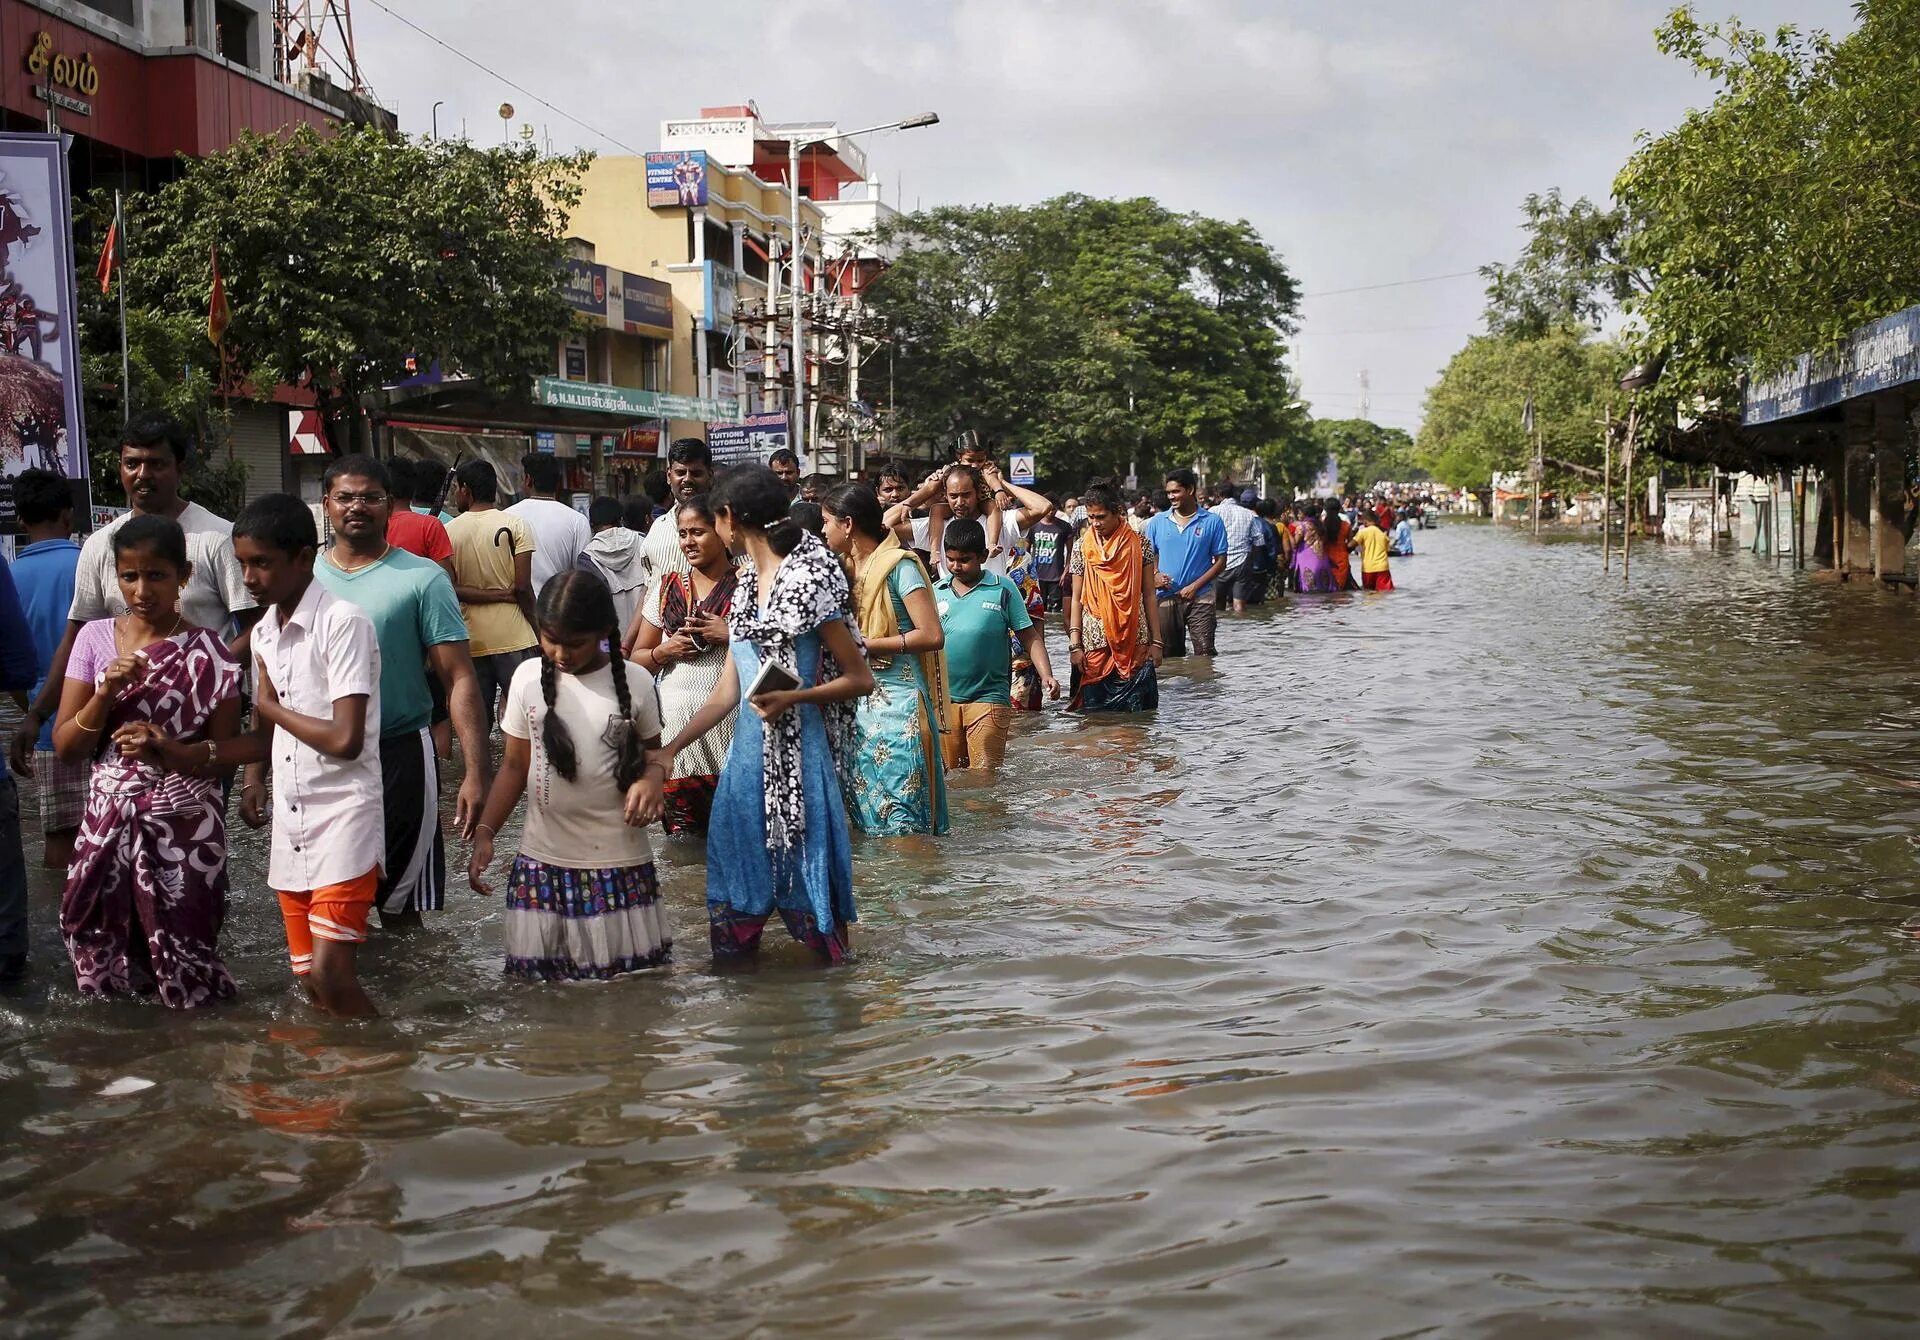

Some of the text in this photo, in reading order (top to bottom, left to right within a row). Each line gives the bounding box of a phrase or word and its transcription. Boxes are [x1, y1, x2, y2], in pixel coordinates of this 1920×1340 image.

[648, 168, 673, 176] FITNESS
[648, 176, 673, 184] CENTRE
[710, 431, 744, 440] TUITIONS
[710, 438, 749, 447] TUTORIALS
[710, 445, 749, 454] TYPEWRITING
[712, 453, 737, 461] COMPUTER
[1035, 531, 1058, 542] stay
